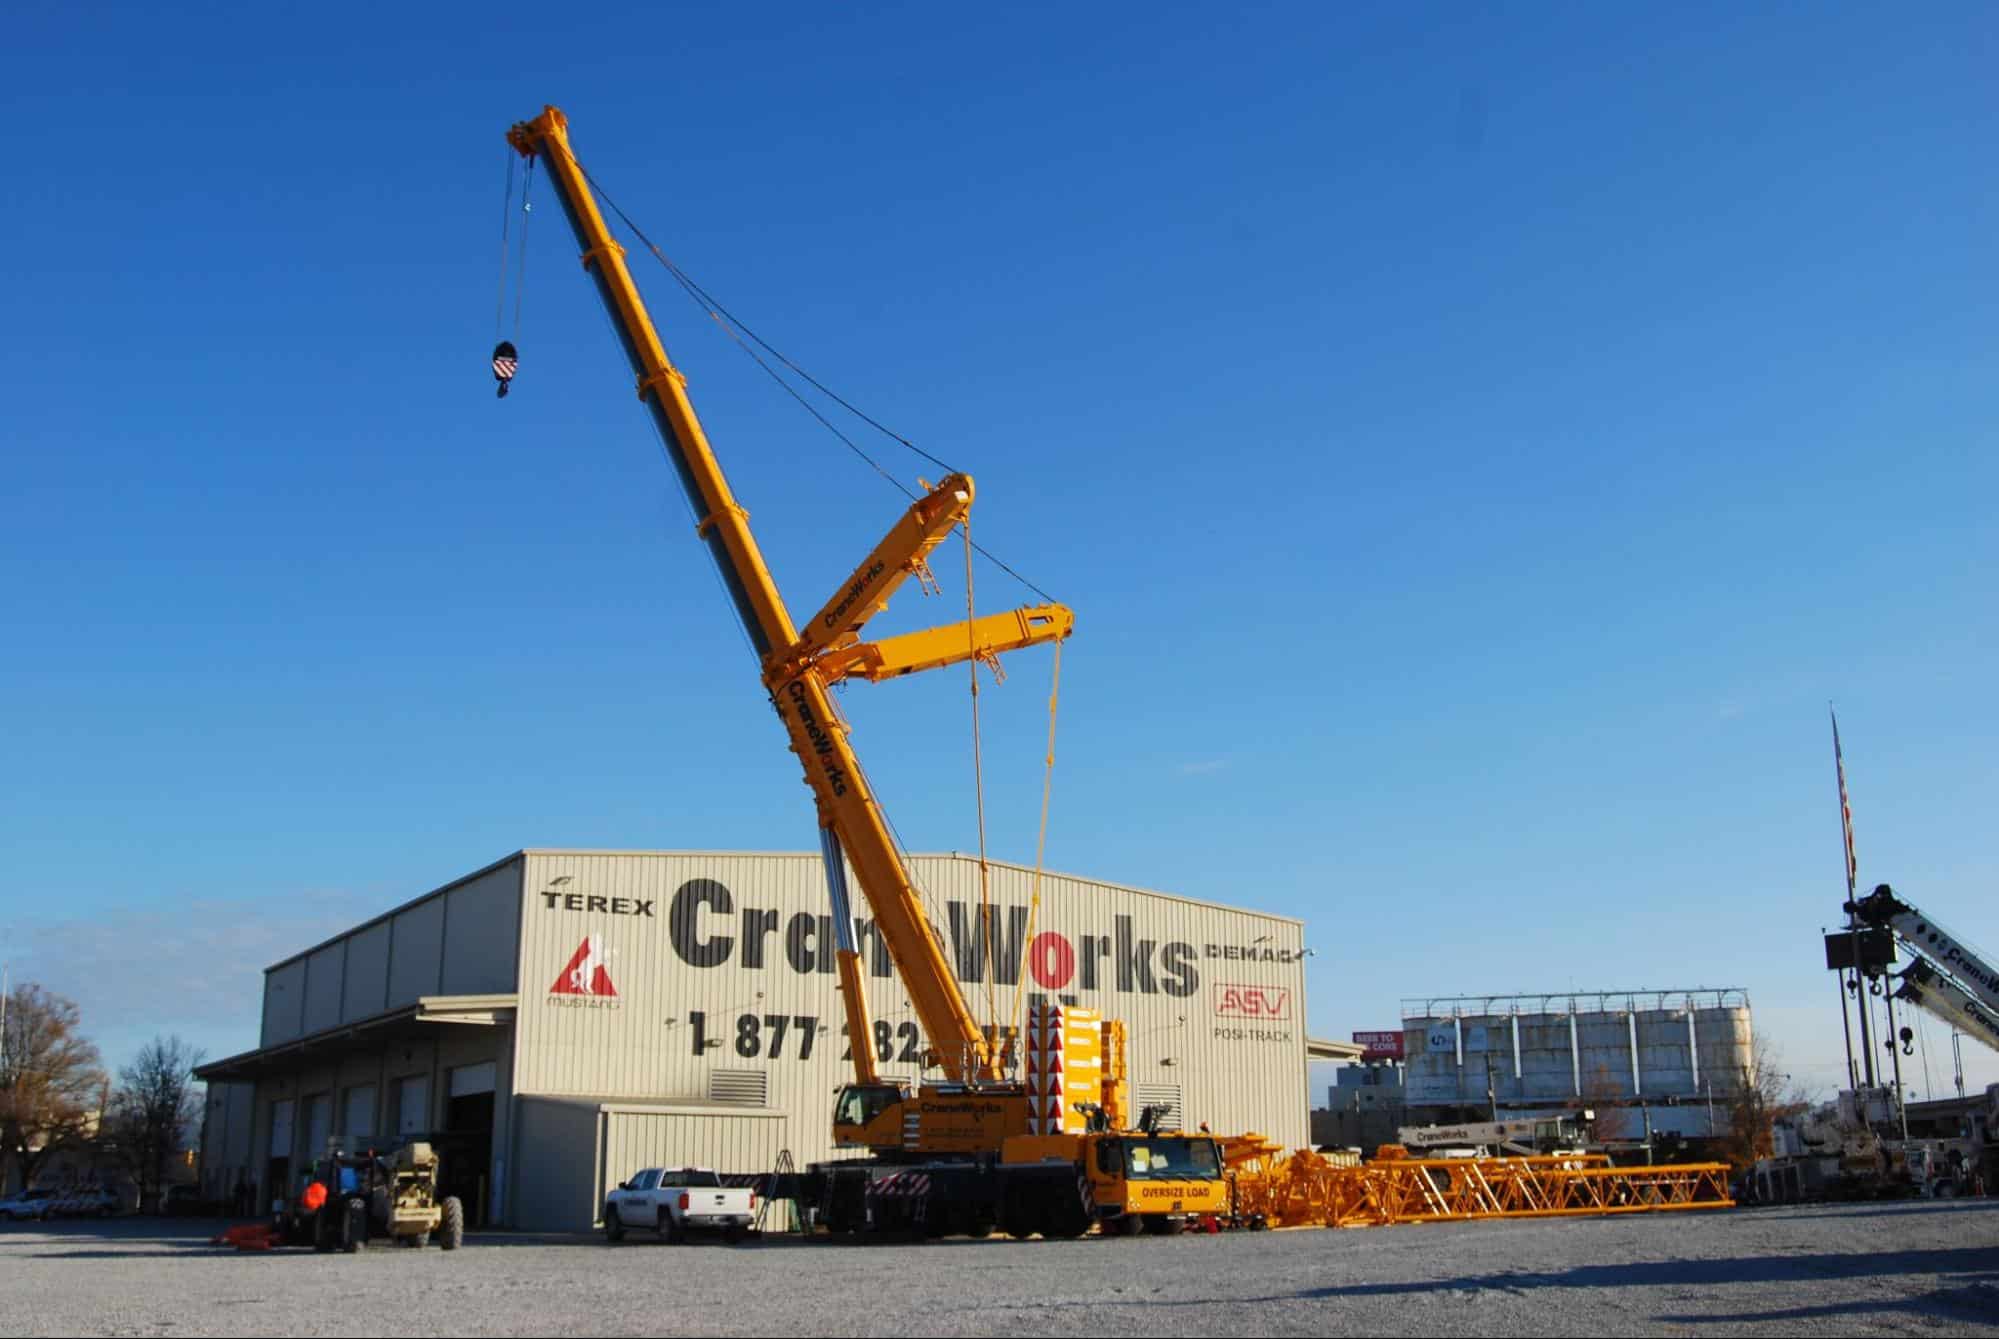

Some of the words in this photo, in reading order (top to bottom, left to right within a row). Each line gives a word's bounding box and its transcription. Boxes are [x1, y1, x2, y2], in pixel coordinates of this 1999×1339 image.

[825, 561, 885, 628] CraneWorks
[789, 680, 847, 797] CraneWorks
[541, 891, 655, 917] TEREX
[1216, 989, 1286, 1015] ASV
[690, 1011, 706, 1056] 1
[735, 1014, 819, 1060] 877
[1214, 1027, 1292, 1041] POSI-TRACK
[1417, 1130, 1468, 1141] CraneWorks
[1142, 1187, 1184, 1198] OVERSIZE
[1187, 1187, 1210, 1198] LOAD
